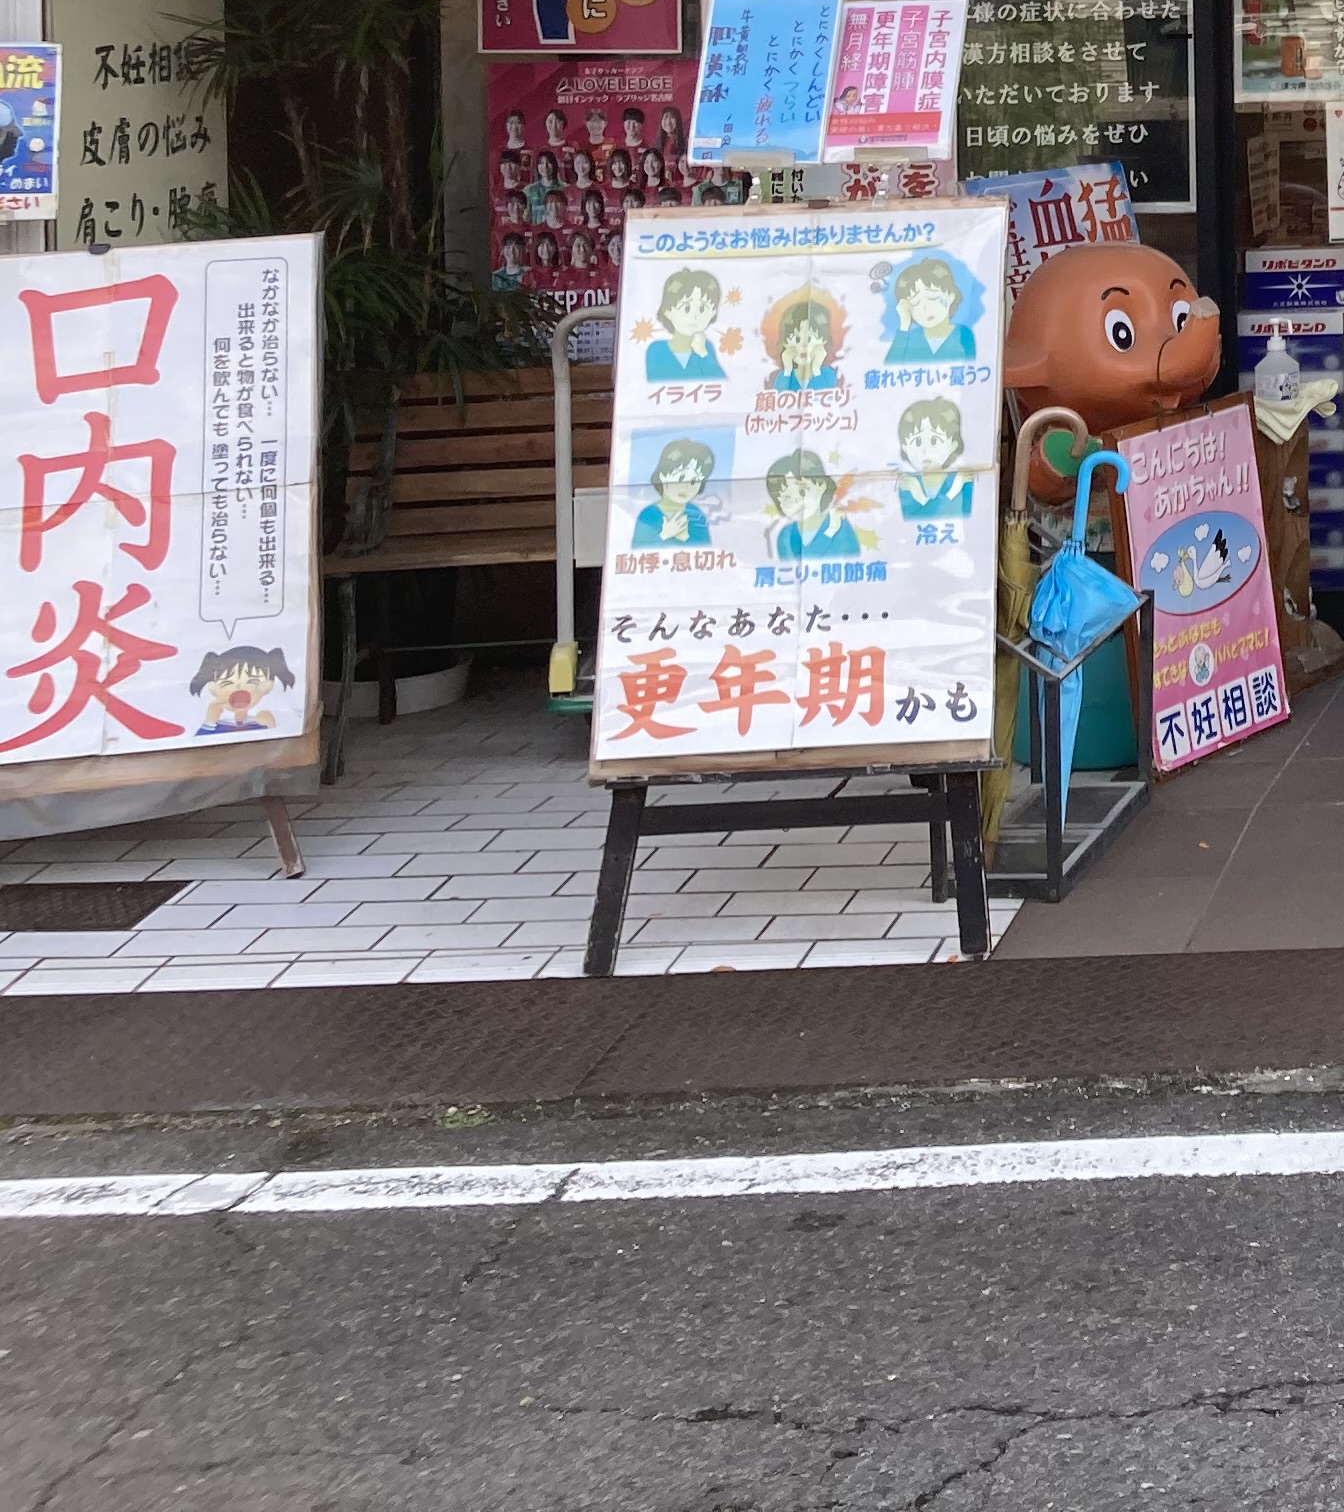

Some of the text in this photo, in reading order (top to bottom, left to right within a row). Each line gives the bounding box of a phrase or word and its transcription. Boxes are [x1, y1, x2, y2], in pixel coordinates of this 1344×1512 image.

[967, 0, 1181, 24] 様の症状に合わせた
[804, 5, 830, 123] とにかくしんどい
[840, 11, 869, 73] 無月経
[862, 10, 897, 114] 更年期障害
[892, 9, 925, 92] 子宮筋腫
[917, 9, 953, 112] 子宮内膜症
[780, 20, 804, 124] とにかくつらい
[966, 124, 1149, 148] 日頃の悩みをぜひ
[637, 221, 936, 256] このようなお悩みはありませんか?
[1262, 258, 1338, 271] リポビタンD
[647, 383, 723, 405] イライラ
[0, 273, 186, 753] 口内炎
[915, 522, 960, 546] 冷え
[614, 549, 737, 574] 動悸・息切れ
[753, 560, 889, 588] 肩こり・関節痛
[1159, 670, 1279, 757] 不妊相談
